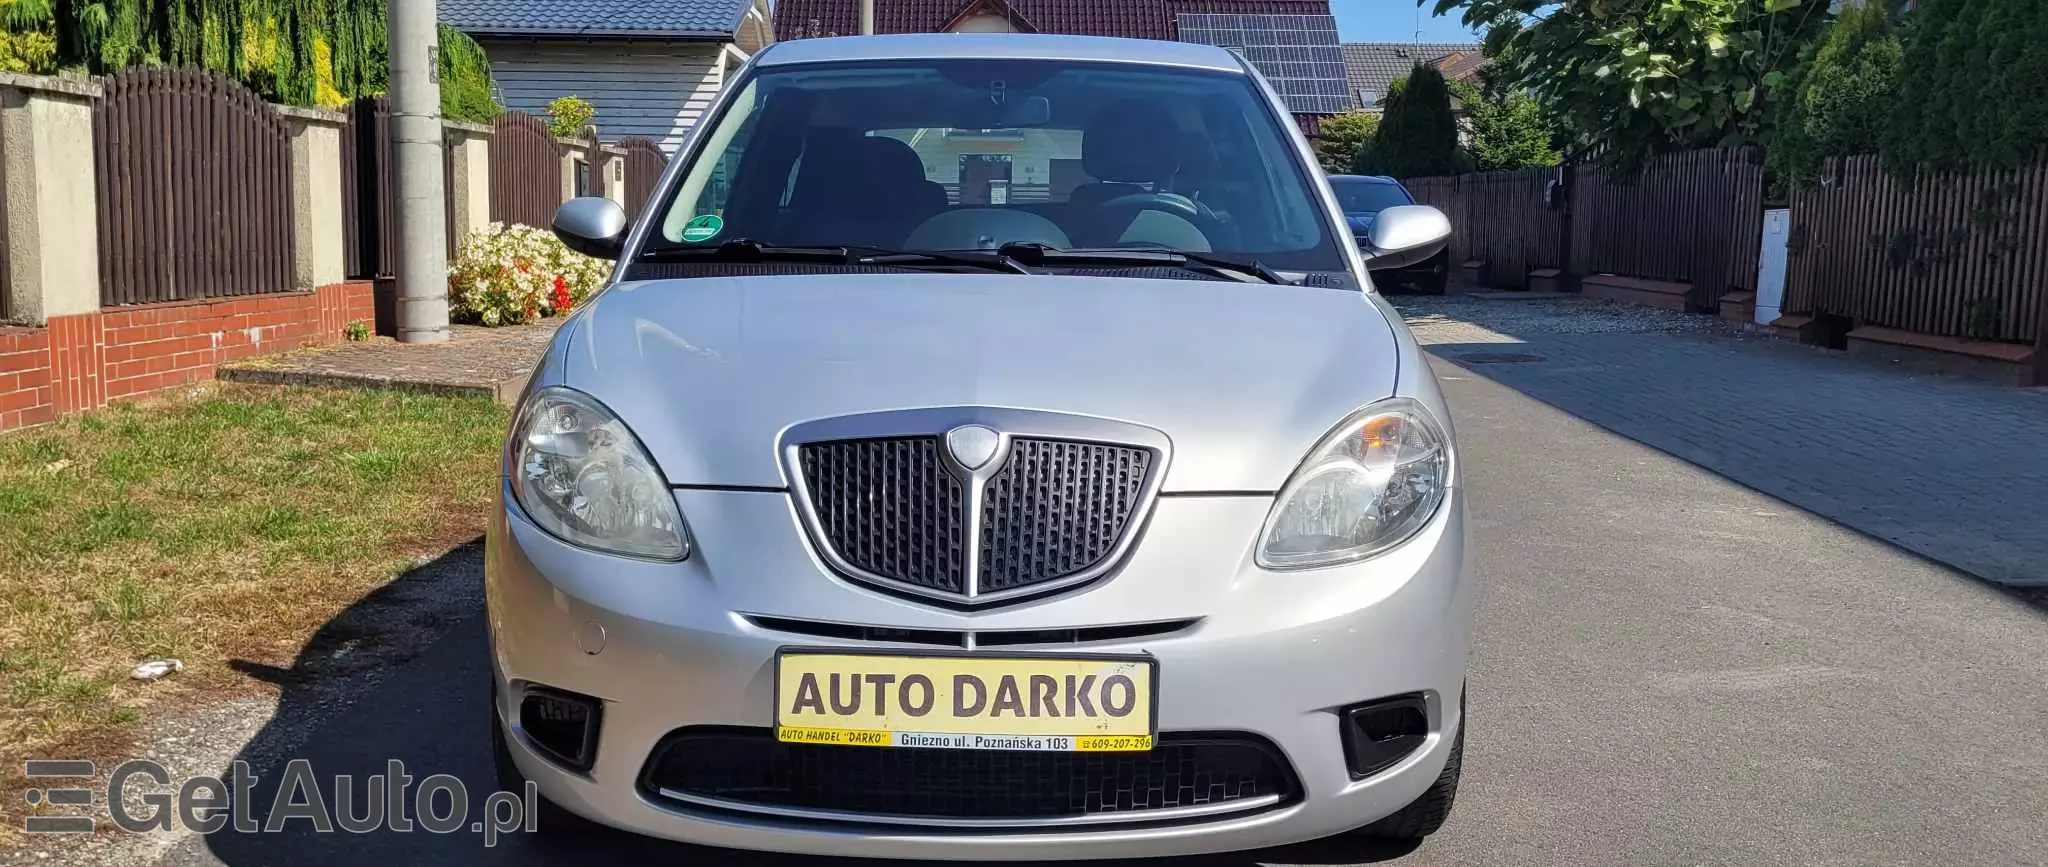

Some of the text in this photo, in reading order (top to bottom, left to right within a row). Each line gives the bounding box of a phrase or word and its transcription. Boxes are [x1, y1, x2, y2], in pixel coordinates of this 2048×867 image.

[791, 672, 1136, 718] AUTO DARKO
[780, 729, 803, 740] AUTO
[806, 731, 840, 741] HANDEL
[901, 733, 1069, 749] Gniezno ul. Poznańska 103
[1091, 738, 1151, 748] 609-207-296
